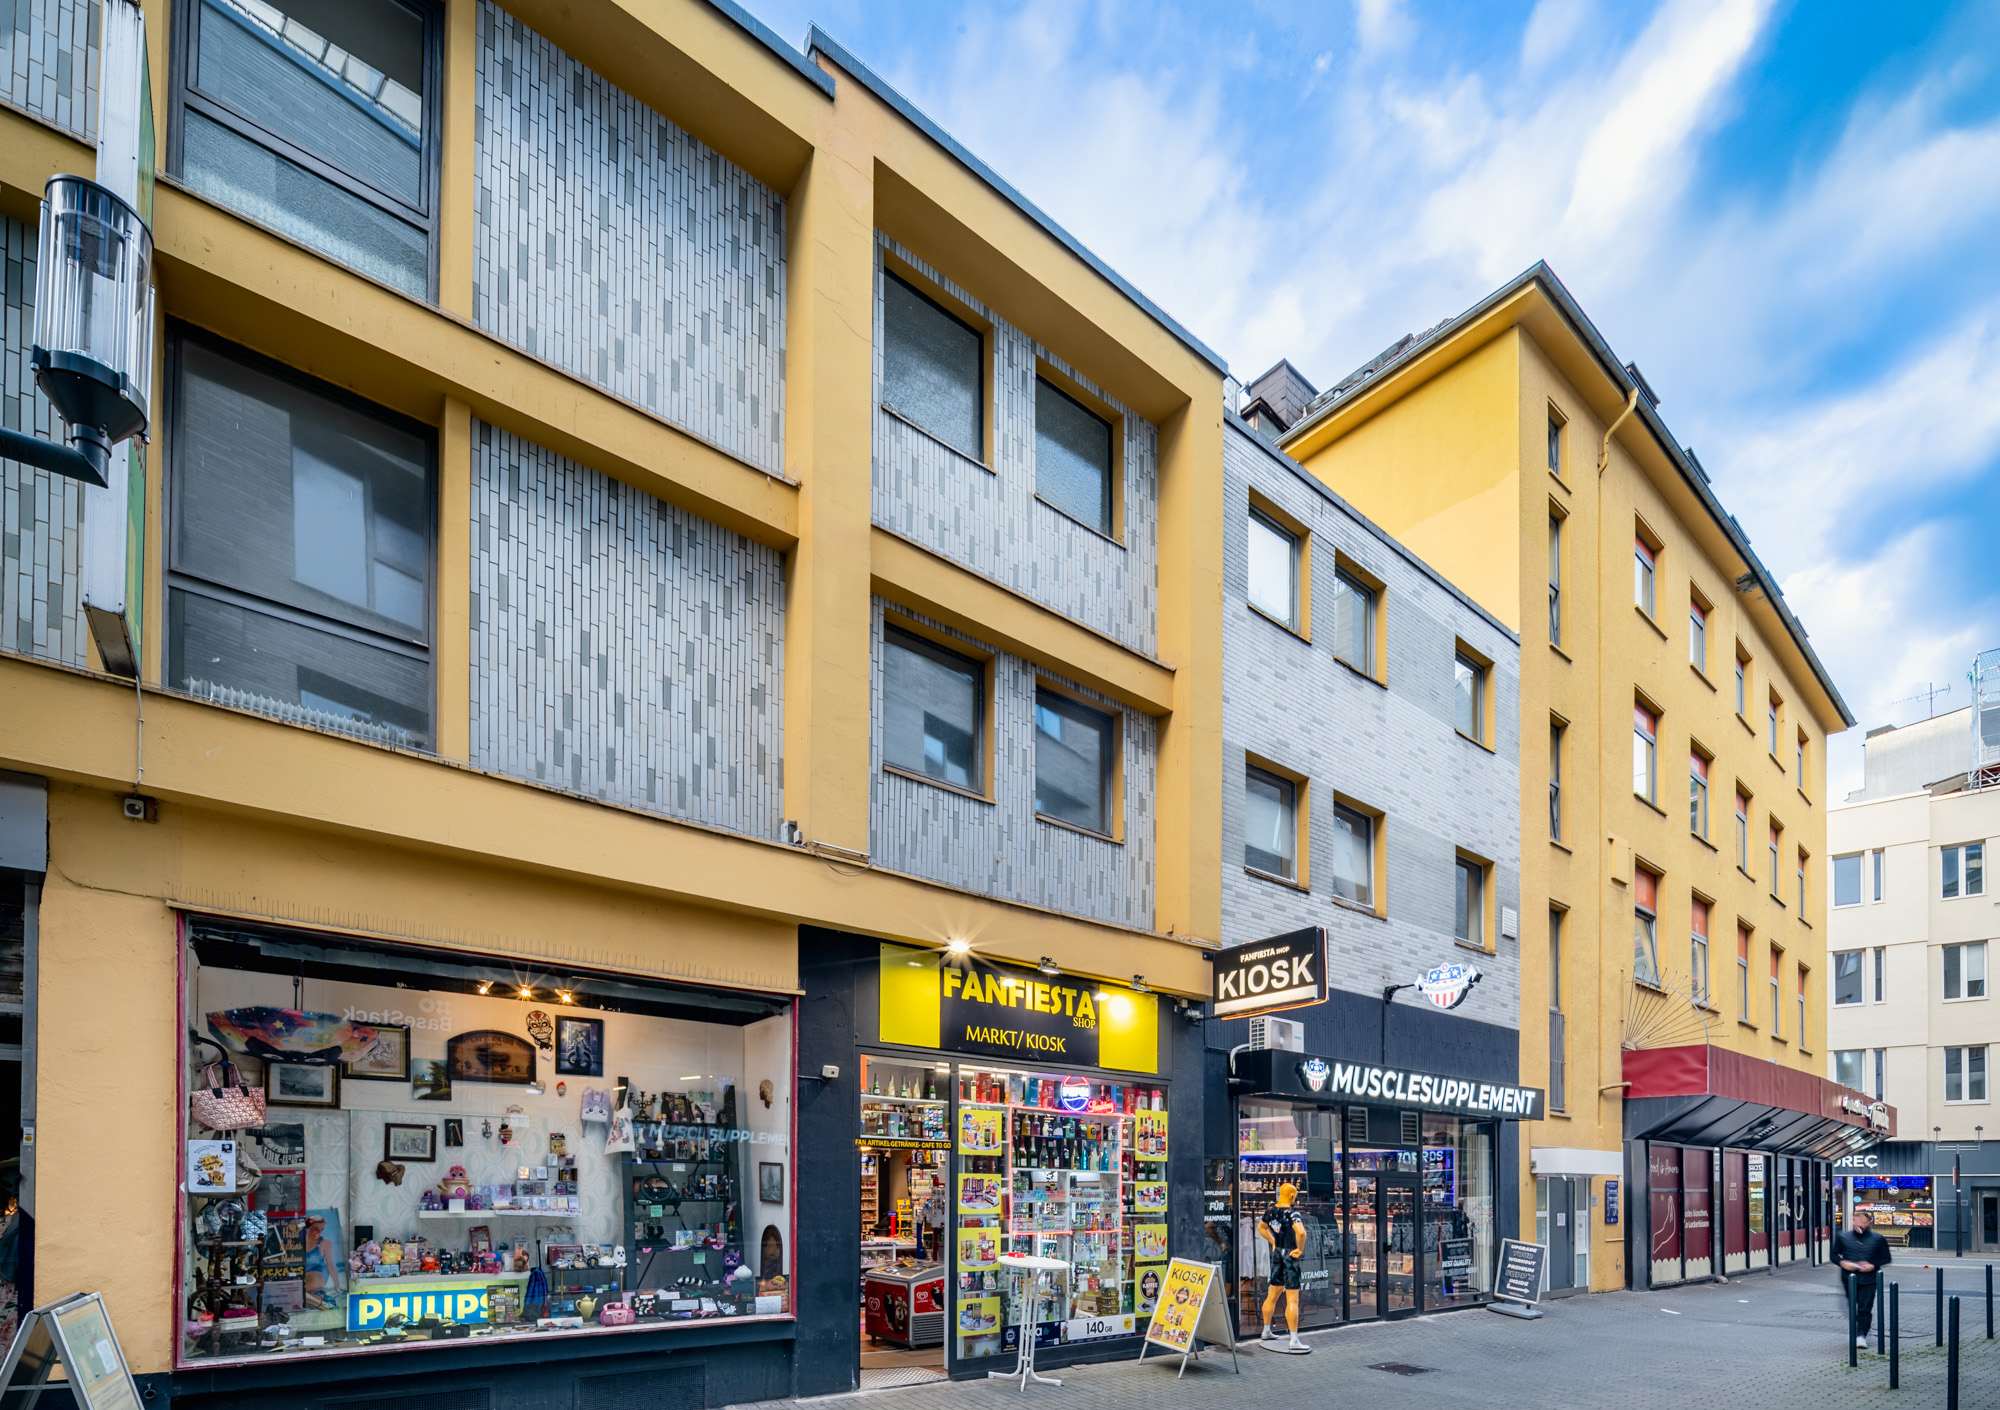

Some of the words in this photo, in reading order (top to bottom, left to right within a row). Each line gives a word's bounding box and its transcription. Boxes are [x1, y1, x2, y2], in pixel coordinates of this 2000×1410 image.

[1240, 947, 1275, 963] FANFIESTA
[1276, 946, 1290, 955] SHOP
[1219, 953, 1314, 999] KIOSK
[943, 967, 1096, 1019] FANFIESTA
[1073, 1017, 1096, 1029] SHOP
[1026, 1033, 1066, 1053] KIOSK
[1332, 1063, 1536, 1114] MUSCLESUPPLEMENT
[1209, 1201, 1224, 1211] FÜR
[1511, 1244, 1537, 1253] UPGRADE
[1508, 1256, 1536, 1265] WORKOUT
[1301, 1270, 1328, 1280] VITAMINS
[1507, 1263, 1535, 1273] PREMIUM
[1171, 1268, 1206, 1286] KIOSK
[1509, 1278, 1529, 1287] INSIDE
[359, 1293, 488, 1325] PHILIPS
[1086, 1321, 1104, 1335] 140
[1105, 1325, 1112, 1333] GB
